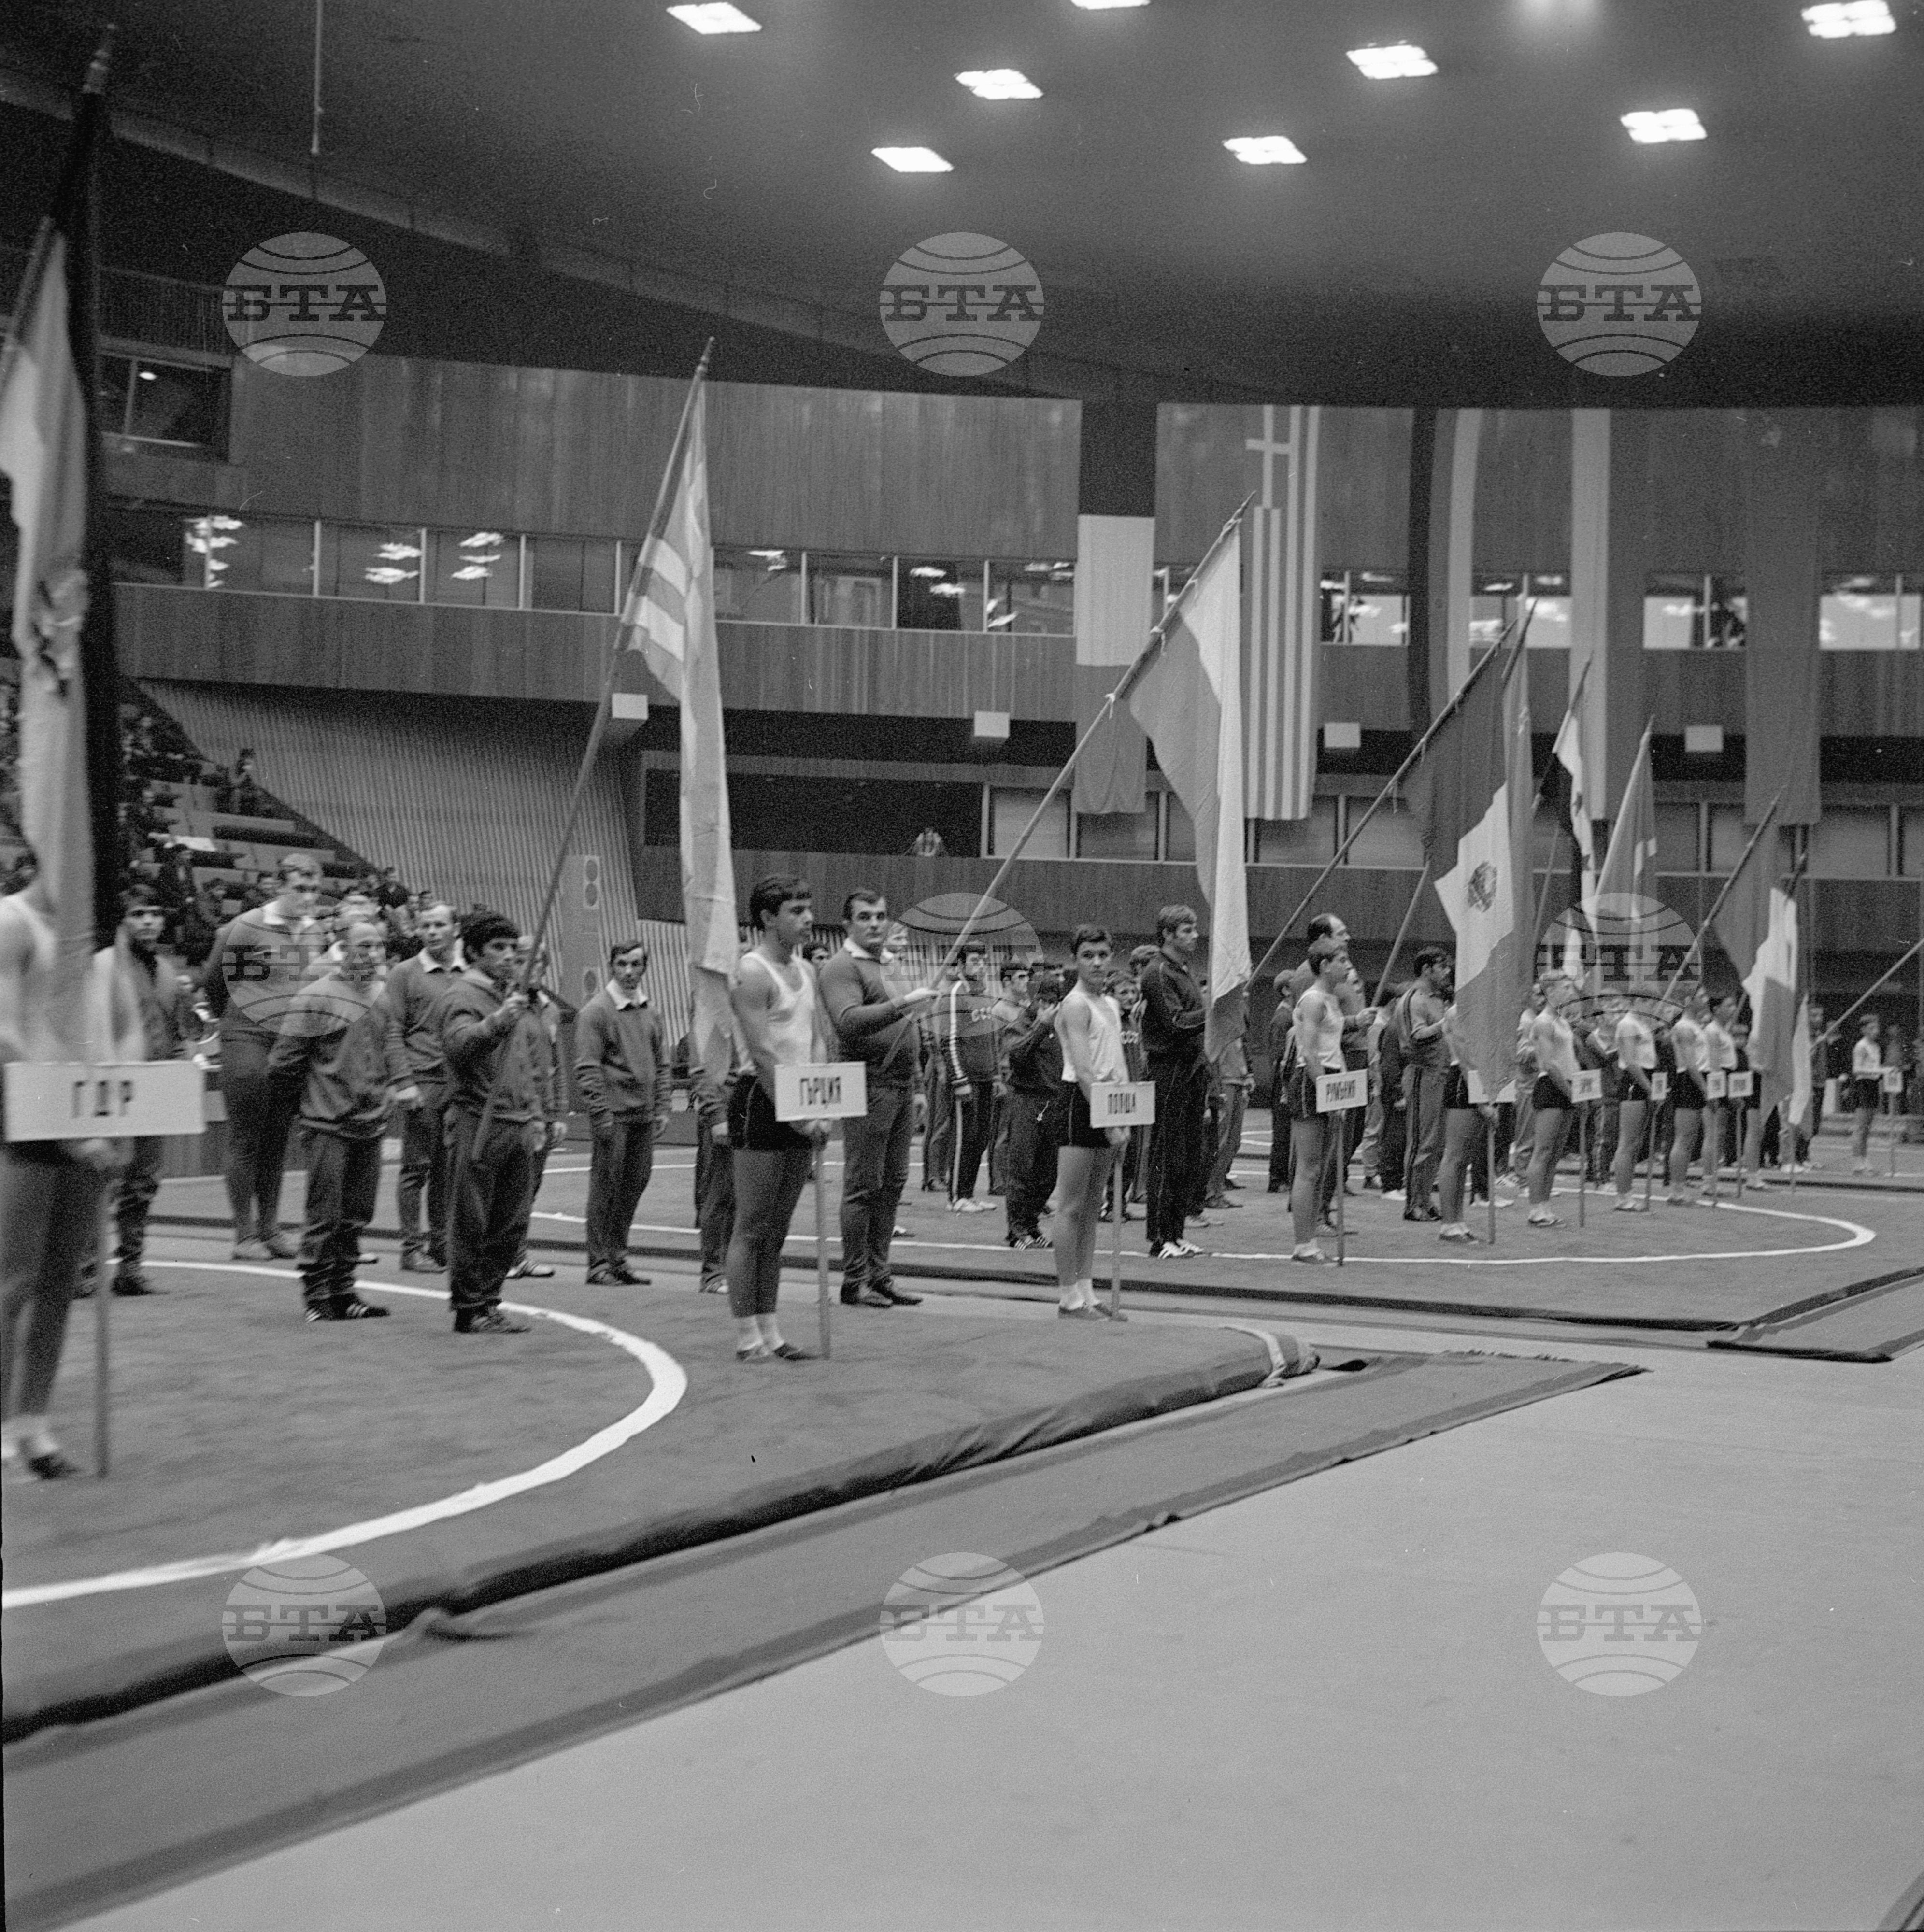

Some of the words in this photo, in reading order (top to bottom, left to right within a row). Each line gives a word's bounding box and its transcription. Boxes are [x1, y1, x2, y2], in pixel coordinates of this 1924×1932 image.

[72, 1080, 133, 1118] ГДР
[800, 1076, 841, 1109] ГЪРЦИЯ
[1107, 1092, 1136, 1114] ПОЛША
[1325, 1079, 1356, 1103] РУМЪНИЯ
